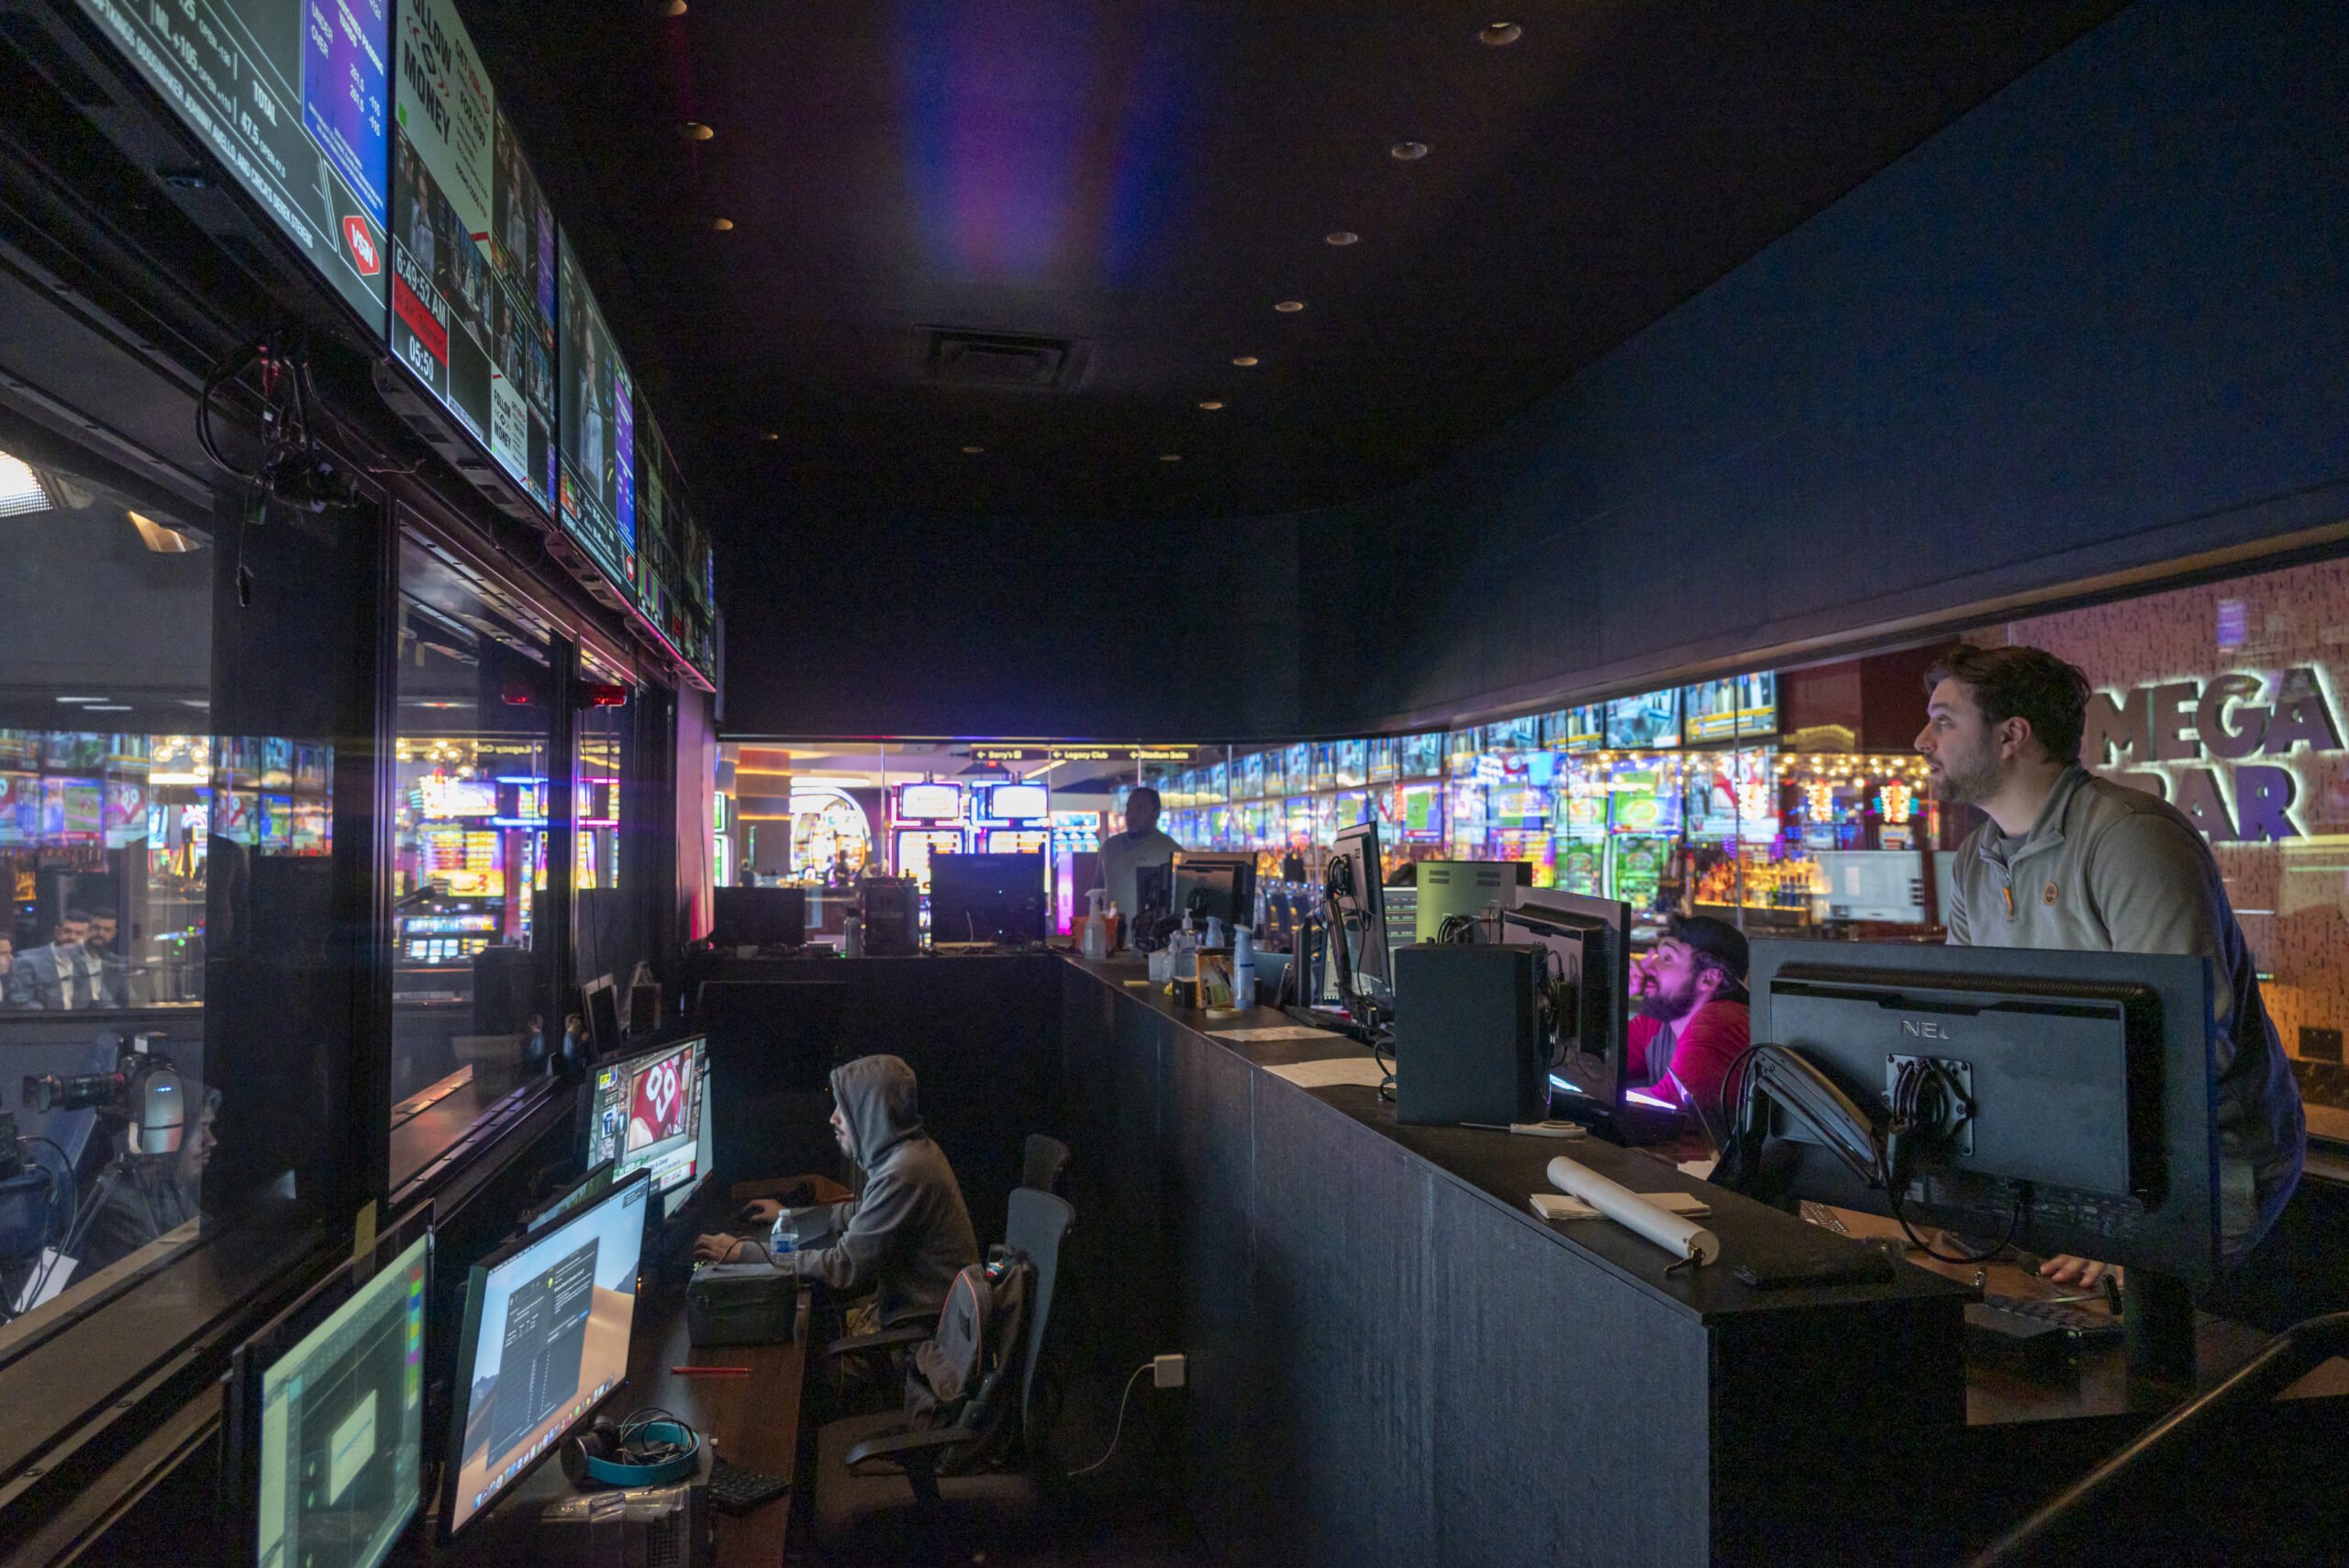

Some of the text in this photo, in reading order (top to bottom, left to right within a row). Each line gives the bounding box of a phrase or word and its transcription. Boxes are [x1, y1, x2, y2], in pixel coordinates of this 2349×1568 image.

[312, 0, 333, 44] UNDER
[312, 24, 328, 60] OVER
[253, 80, 277, 127] TOTAL
[405, 40, 451, 146] MONEY
[240, 111, 259, 147] 47.5
[396, 247, 430, 309] 6:49:52
[431, 293, 446, 330] AM
[409, 335, 433, 383] 05:50
[2085, 667, 2345, 764] MEGA
[2092, 766, 2301, 843] AR
